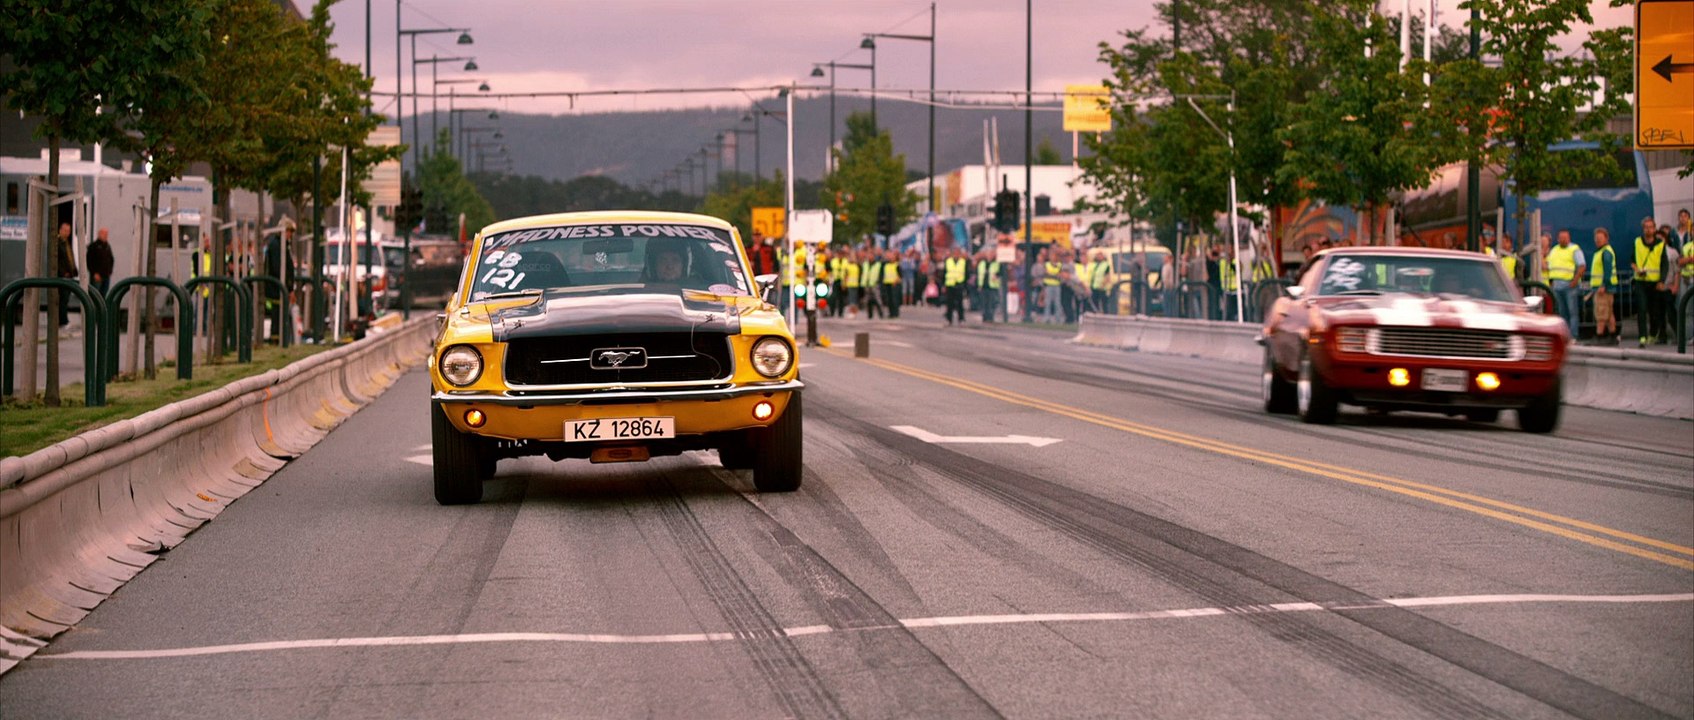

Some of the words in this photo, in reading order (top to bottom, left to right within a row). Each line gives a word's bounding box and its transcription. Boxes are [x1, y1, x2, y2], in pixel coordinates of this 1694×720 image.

[487, 225, 615, 251] MADNESS
[620, 225, 729, 245] POWER
[481, 267, 526, 290] 121
[574, 420, 601, 440] KZ
[612, 419, 665, 438] 12864
